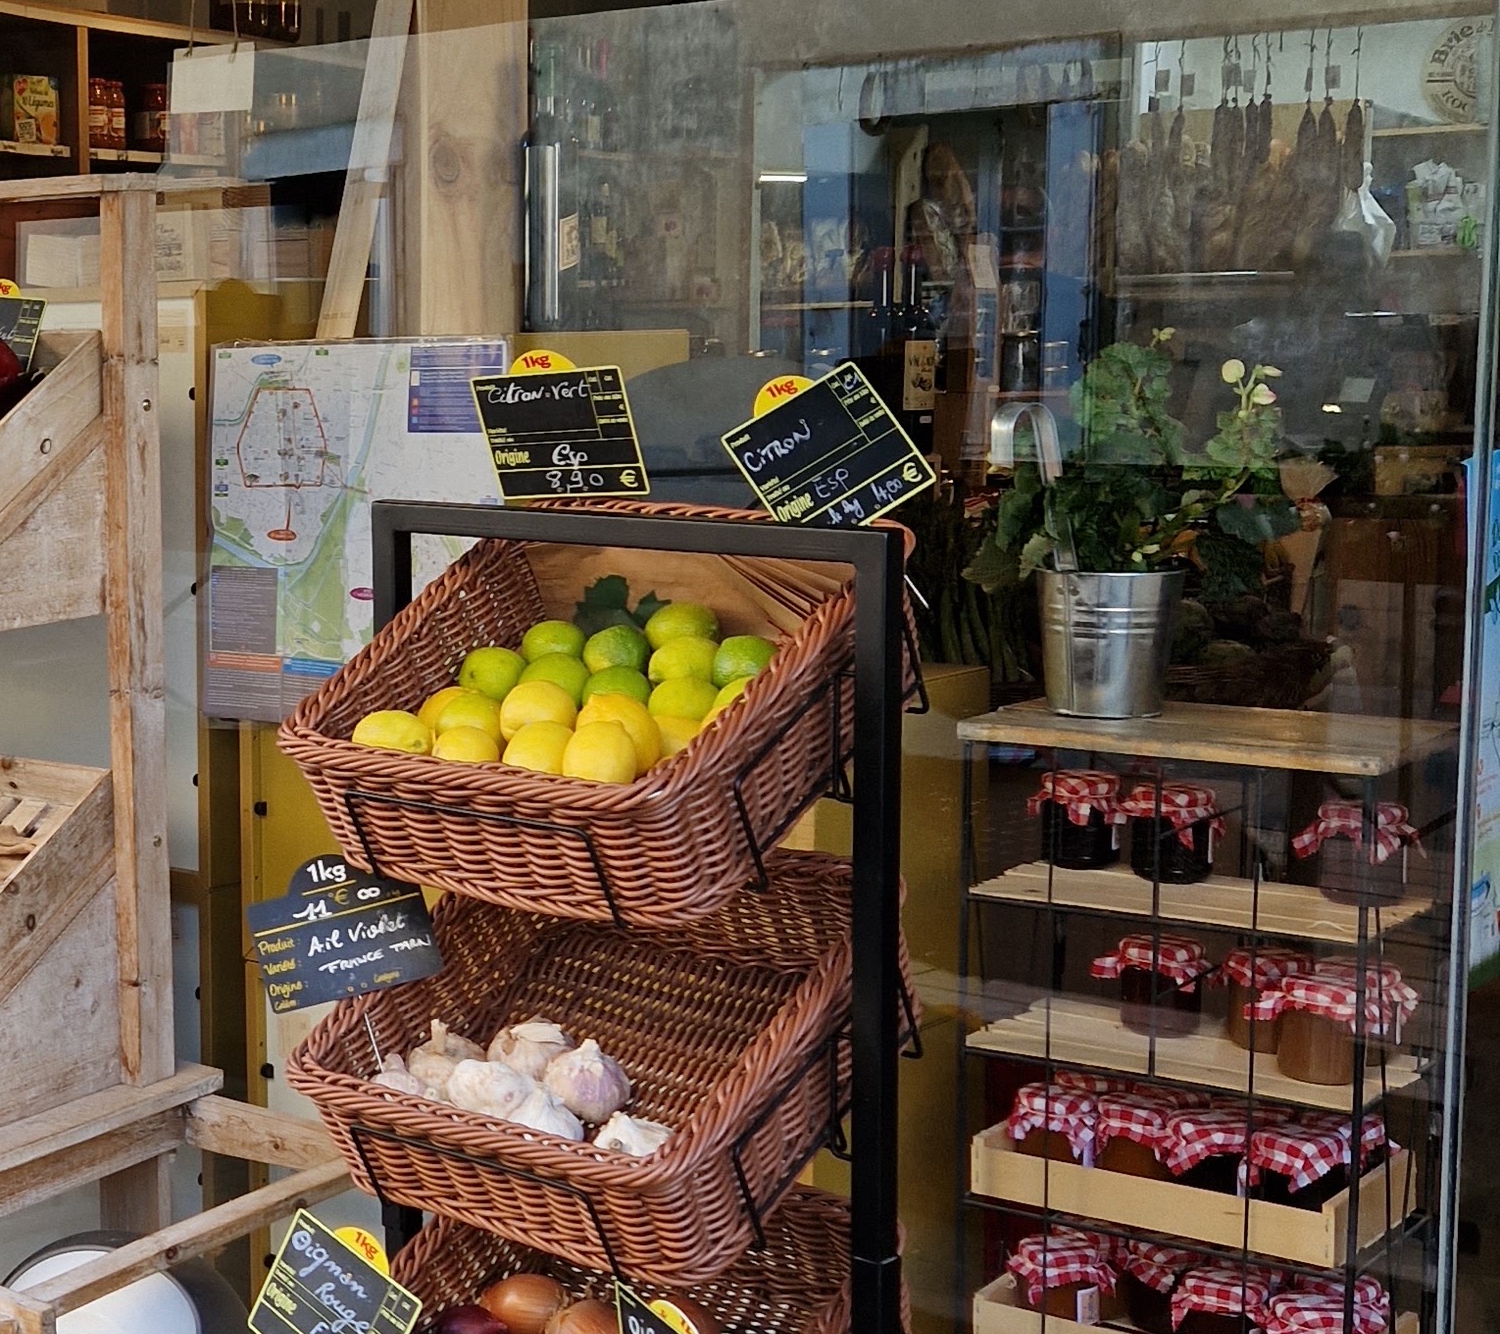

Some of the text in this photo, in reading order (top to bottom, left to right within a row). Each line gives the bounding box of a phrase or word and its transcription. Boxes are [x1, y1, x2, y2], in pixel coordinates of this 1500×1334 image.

[521, 354, 552, 369] 1kg
[765, 379, 799, 399] 1kg
[494, 449, 532, 466] Origine
[618, 469, 639, 488] €
[902, 461, 923, 483] €
[776, 491, 815, 523] Origine
[306, 859, 347, 883] 1kg
[355, 1231, 379, 1261] 1kg
